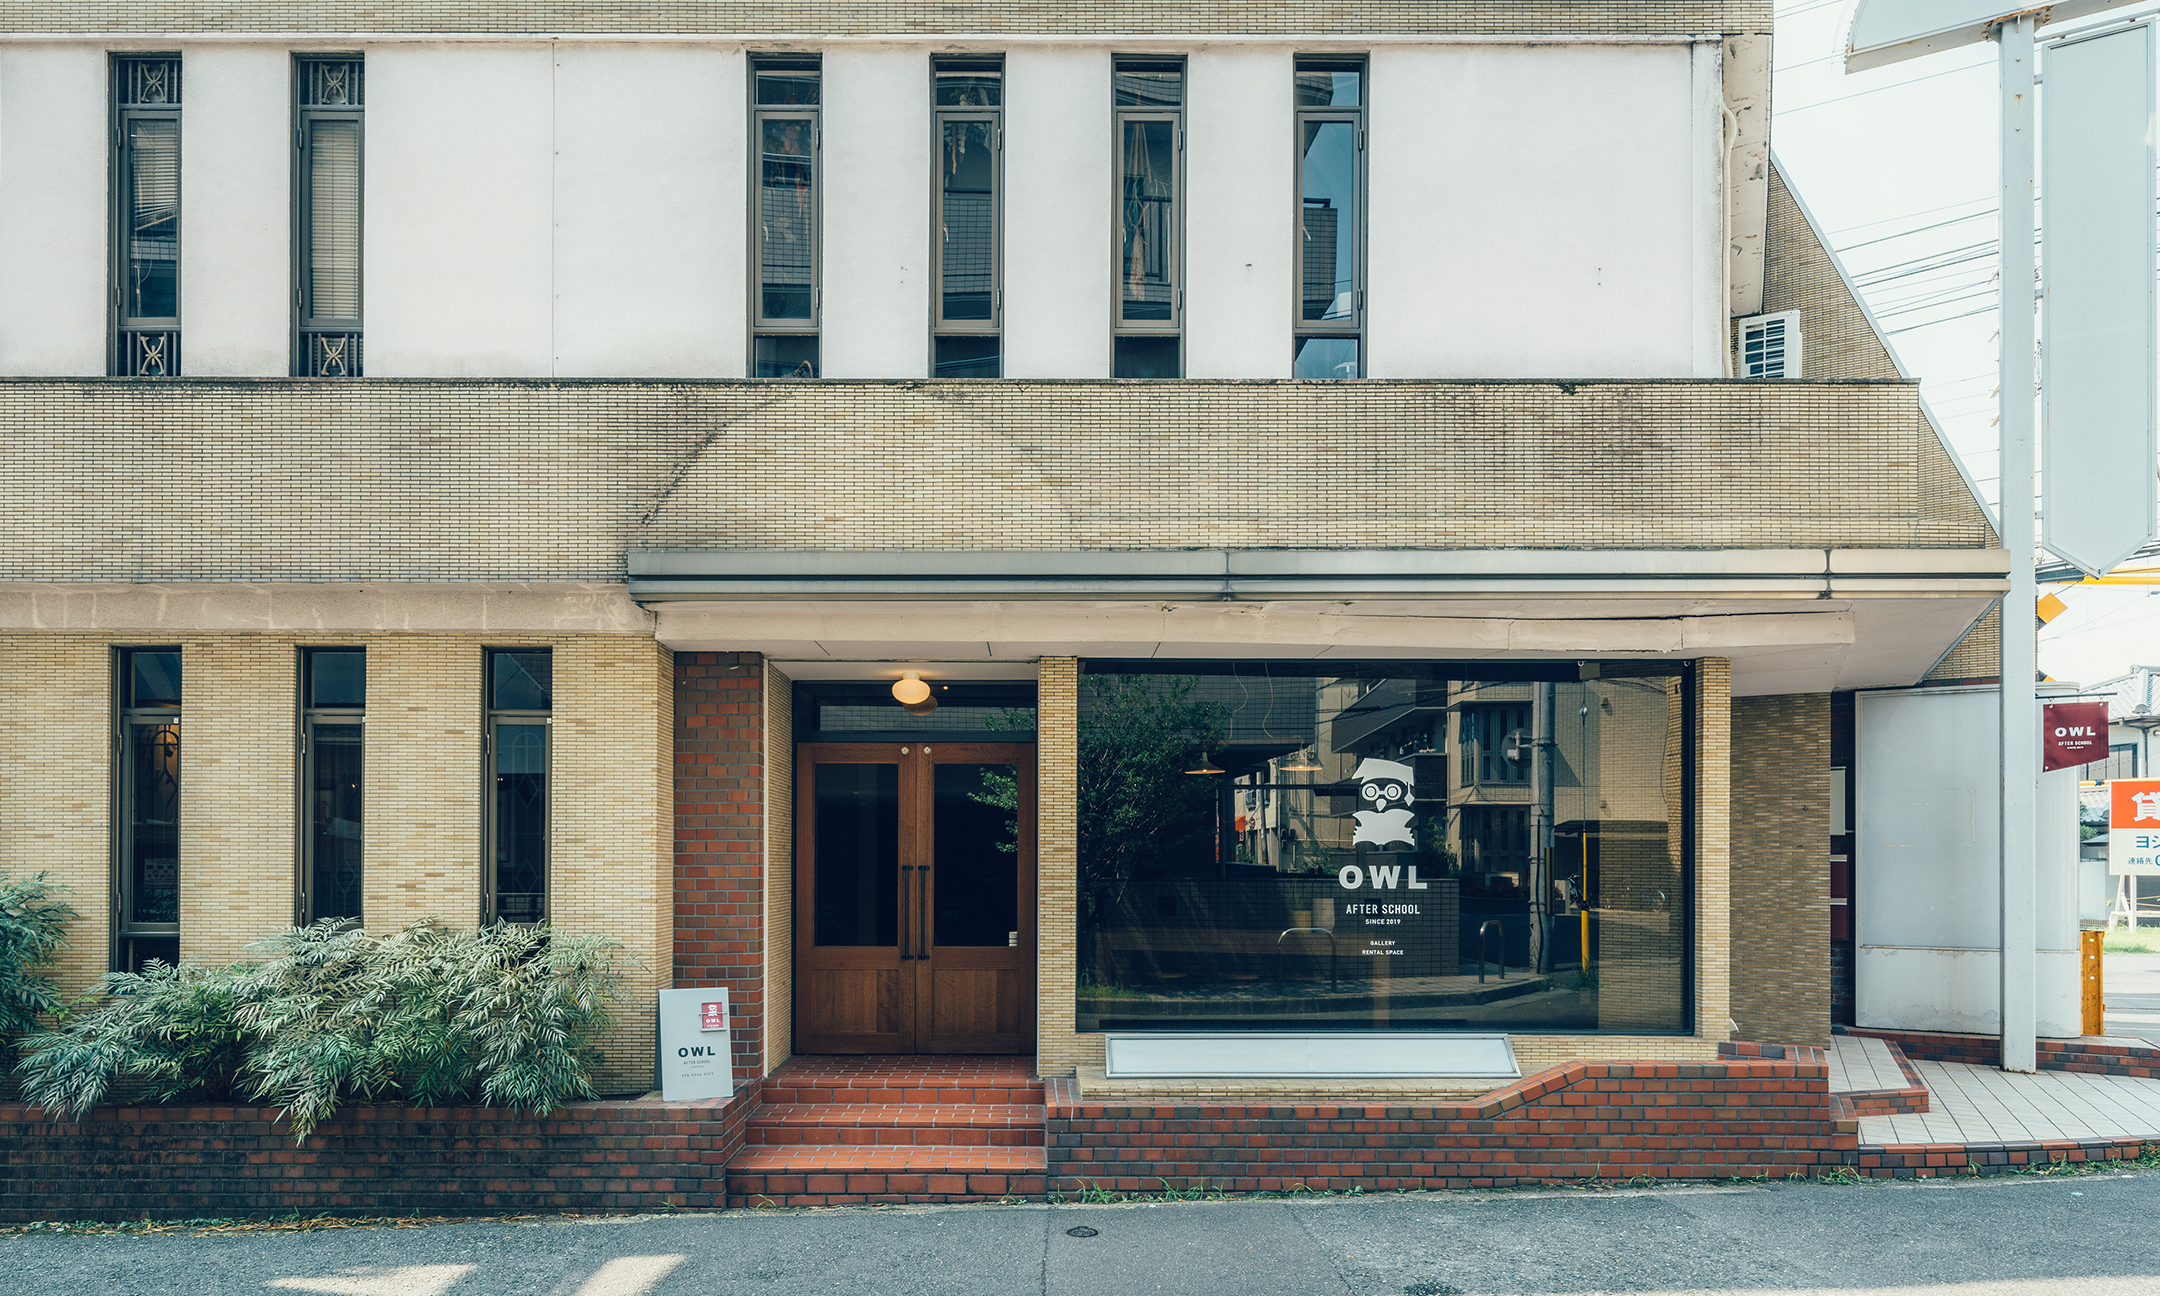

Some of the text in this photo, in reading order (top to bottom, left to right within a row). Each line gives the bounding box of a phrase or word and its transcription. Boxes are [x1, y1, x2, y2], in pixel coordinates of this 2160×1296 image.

[2055, 726, 2096, 737] OWL
[2131, 791, 2160, 822] 貸
[2128, 857, 2152, 865] 連絡先
[1339, 865, 1427, 889] OWL
[1346, 904, 1420, 914] AFTER SCHOOL
[678, 1046, 715, 1057] OWL
